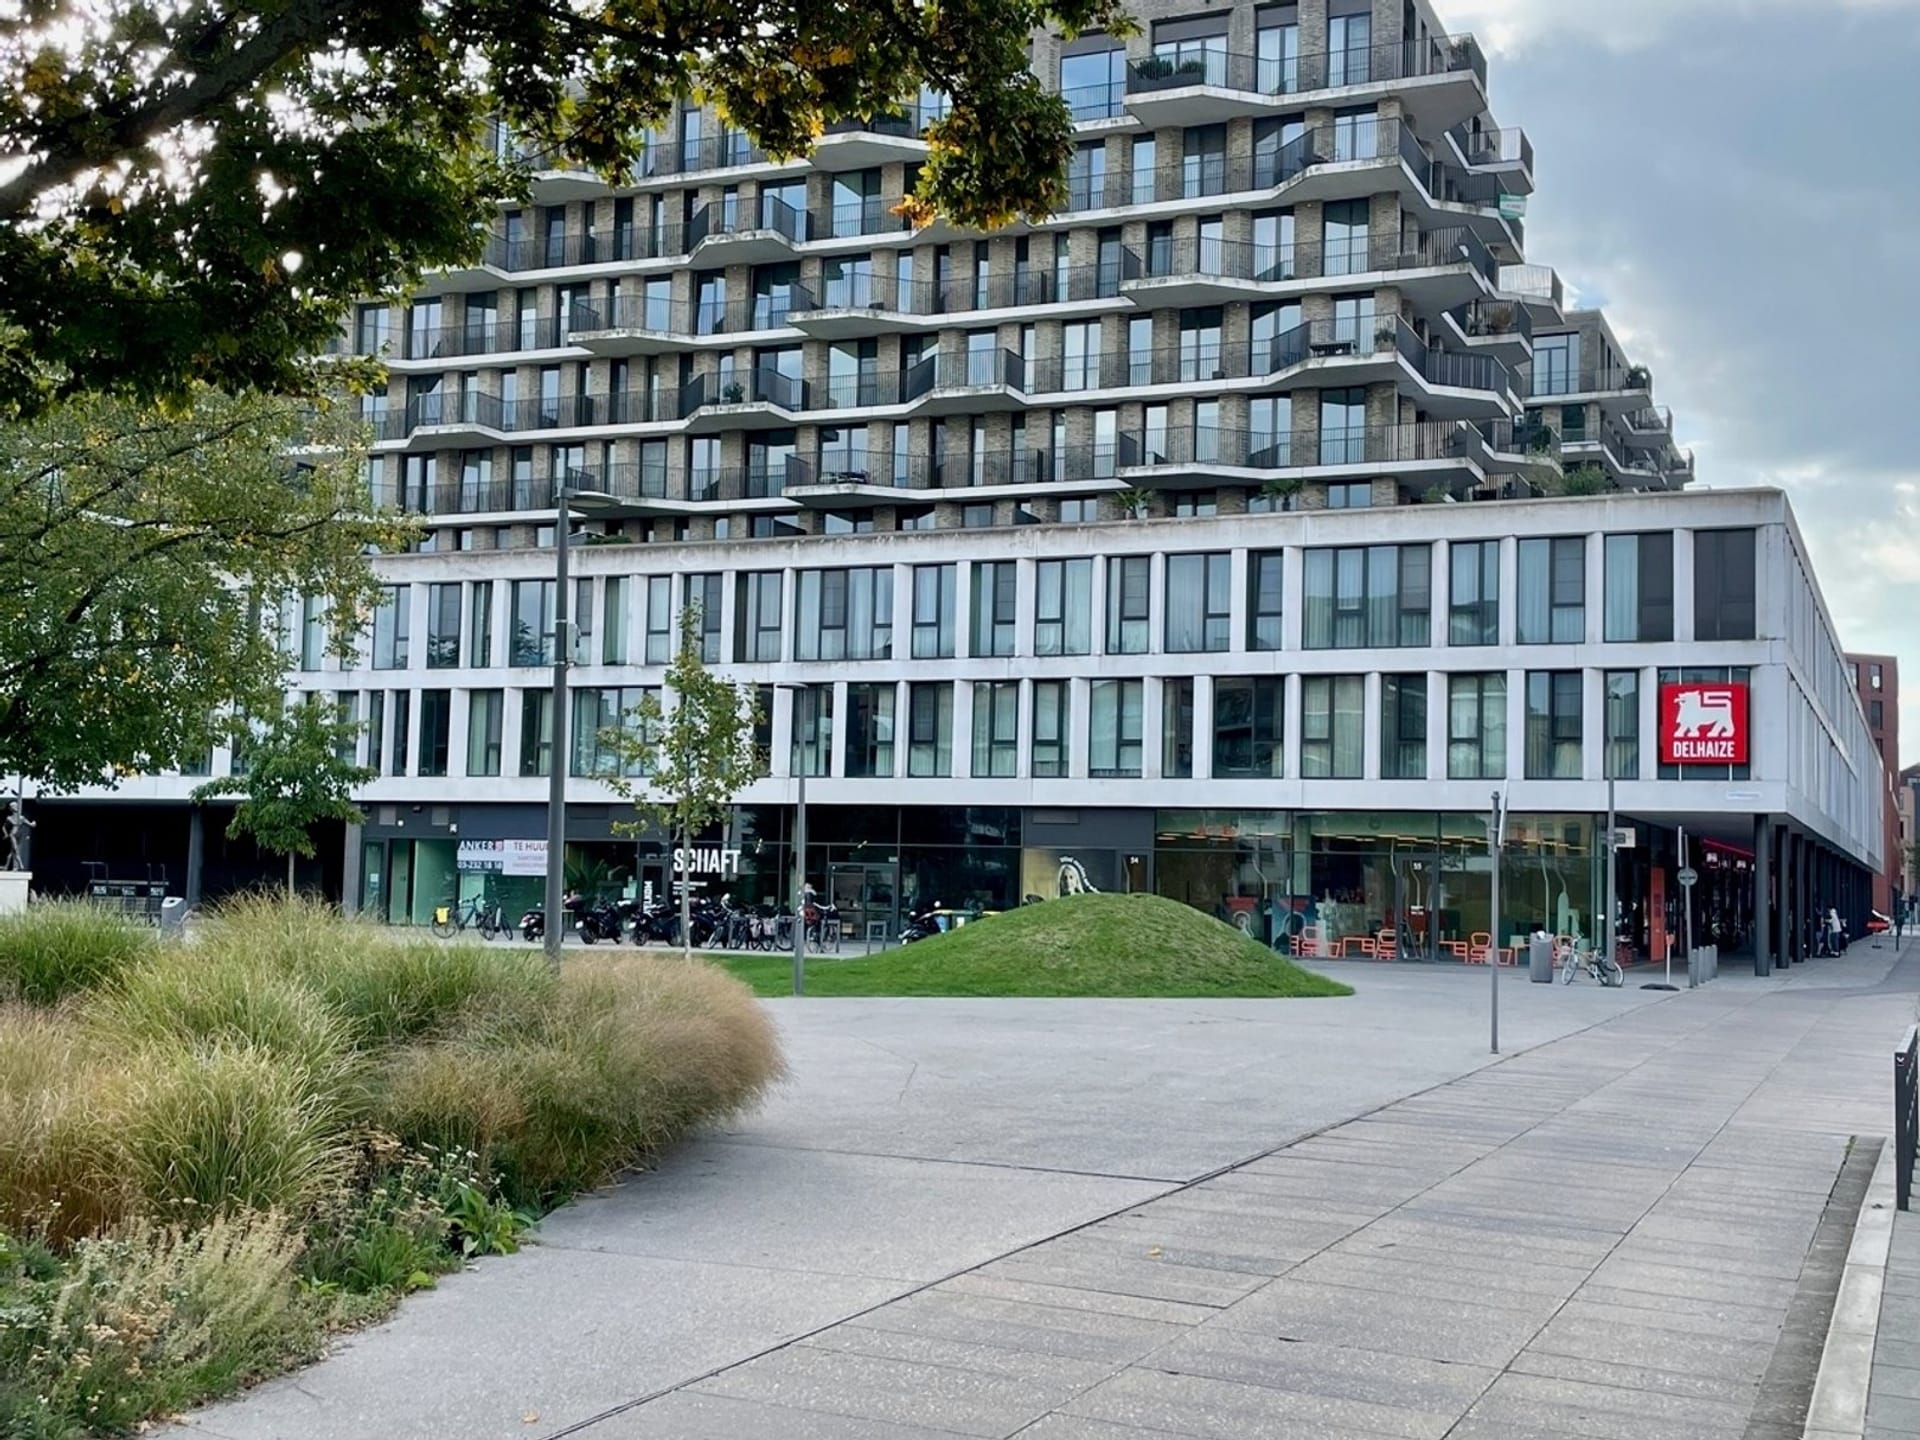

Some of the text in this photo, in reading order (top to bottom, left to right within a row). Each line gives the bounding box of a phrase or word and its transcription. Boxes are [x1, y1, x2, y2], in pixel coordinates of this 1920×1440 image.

[1673, 741, 1735, 758] DELHAIZE
[460, 840, 494, 851] ANKER
[514, 841, 548, 852] TE HUU
[673, 848, 742, 873] SCHAFT
